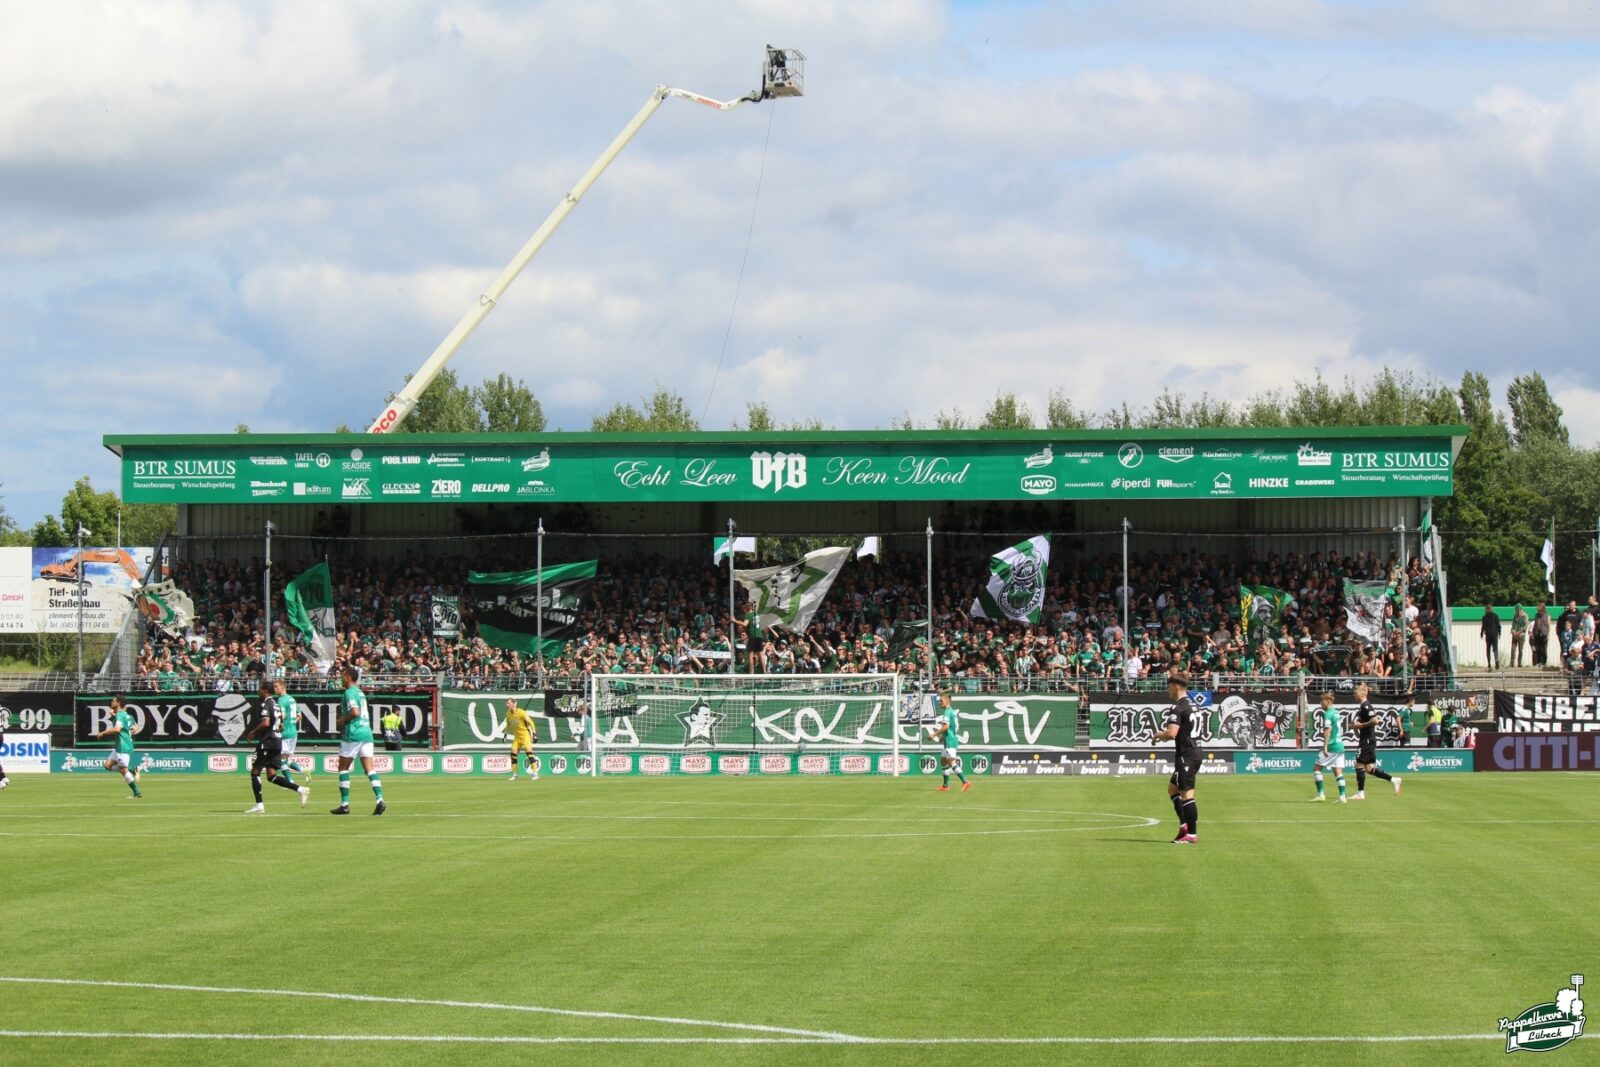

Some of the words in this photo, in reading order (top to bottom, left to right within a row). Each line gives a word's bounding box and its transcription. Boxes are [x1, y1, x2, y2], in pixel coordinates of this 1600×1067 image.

[1158, 446, 1194, 455] clement
[295, 453, 314, 461] TAFEL
[382, 456, 401, 464] POOL
[1342, 452, 1379, 467] BTR
[1384, 452, 1449, 467] SUMUS
[134, 461, 169, 475] BTR
[174, 461, 236, 475] SUMUS
[342, 462, 371, 470] SEASIDE
[822, 456, 889, 485] Keen
[894, 456, 971, 485] Mood
[613, 460, 672, 489] Echt
[1341, 474, 1386, 482] Steuerberatung
[1392, 474, 1449, 482] Wirtschaftsprüfung
[133, 481, 176, 489] Steuerberatung
[181, 481, 236, 489] Wirtschaftsprüfung
[1024, 479, 1053, 488] MAYO
[1122, 478, 1151, 490] iperdi
[1249, 478, 1289, 488] HINZKE
[471, 483, 510, 493] DELLPRO
[49, 588, 70, 597] Tief-
[19, 708, 52, 731] 99
[156, 759, 192, 768] HOLSTEN
[1264, 759, 1302, 768] HOLSTEN
[1425, 758, 1463, 767] HOLSTEN
[998, 764, 1028, 774] bwin
[1035, 764, 1065, 774] bwin
[1081, 765, 1110, 774] bwin
[1118, 763, 1147, 774] bwin
[1199, 763, 1228, 774] bwin
